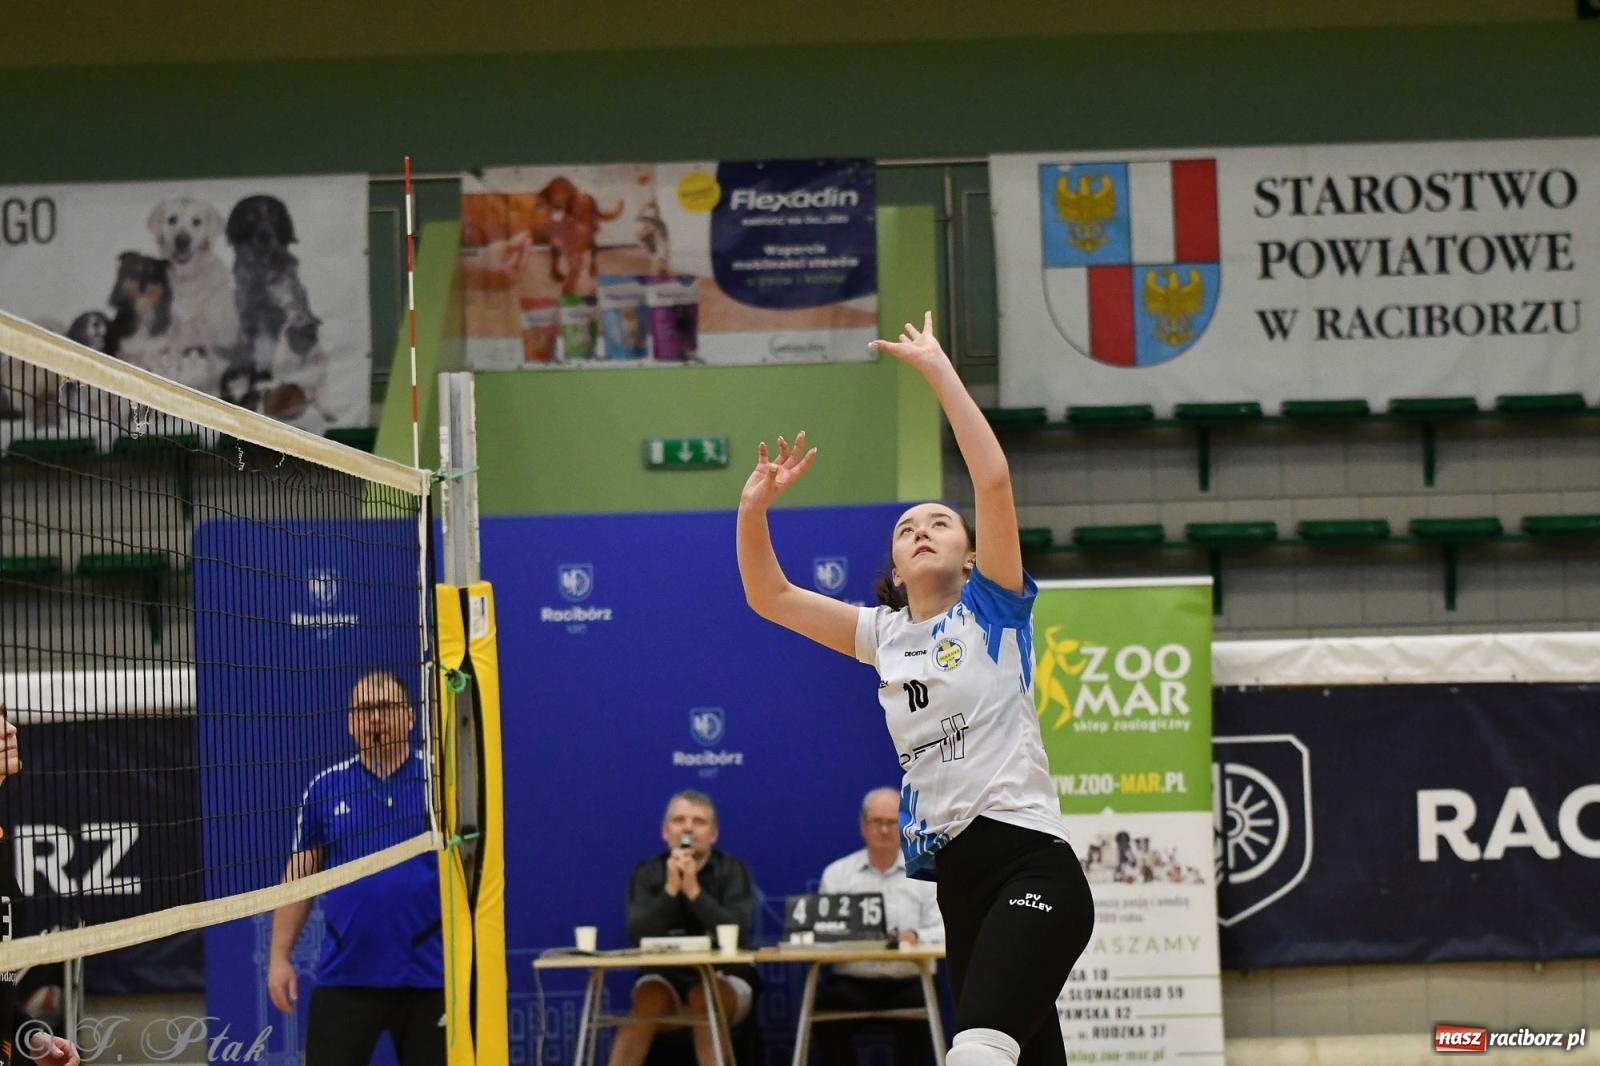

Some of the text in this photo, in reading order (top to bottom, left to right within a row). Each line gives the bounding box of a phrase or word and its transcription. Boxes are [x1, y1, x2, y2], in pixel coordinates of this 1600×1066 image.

[730, 187, 859, 211] Flexadin
[1254, 169, 1578, 219] STAROSTWO
[2, 197, 57, 245] GO
[1257, 233, 1575, 280] POWIATOWE
[1255, 300, 1582, 343] W RACIBORZU
[1079, 643, 1192, 682] ZOO
[903, 679, 929, 713] 10
[1072, 680, 1190, 718] MAR
[1072, 720, 1108, 734] sklep
[14, 822, 142, 897] RZ
[792, 899, 807, 925] 4
[837, 896, 851, 917] 2
[859, 896, 882, 926] 15
[1009, 899, 1053, 912] VOLLEY
[1025, 893, 1041, 901] PV
[1092, 1025, 1144, 1039] RUDZKA
